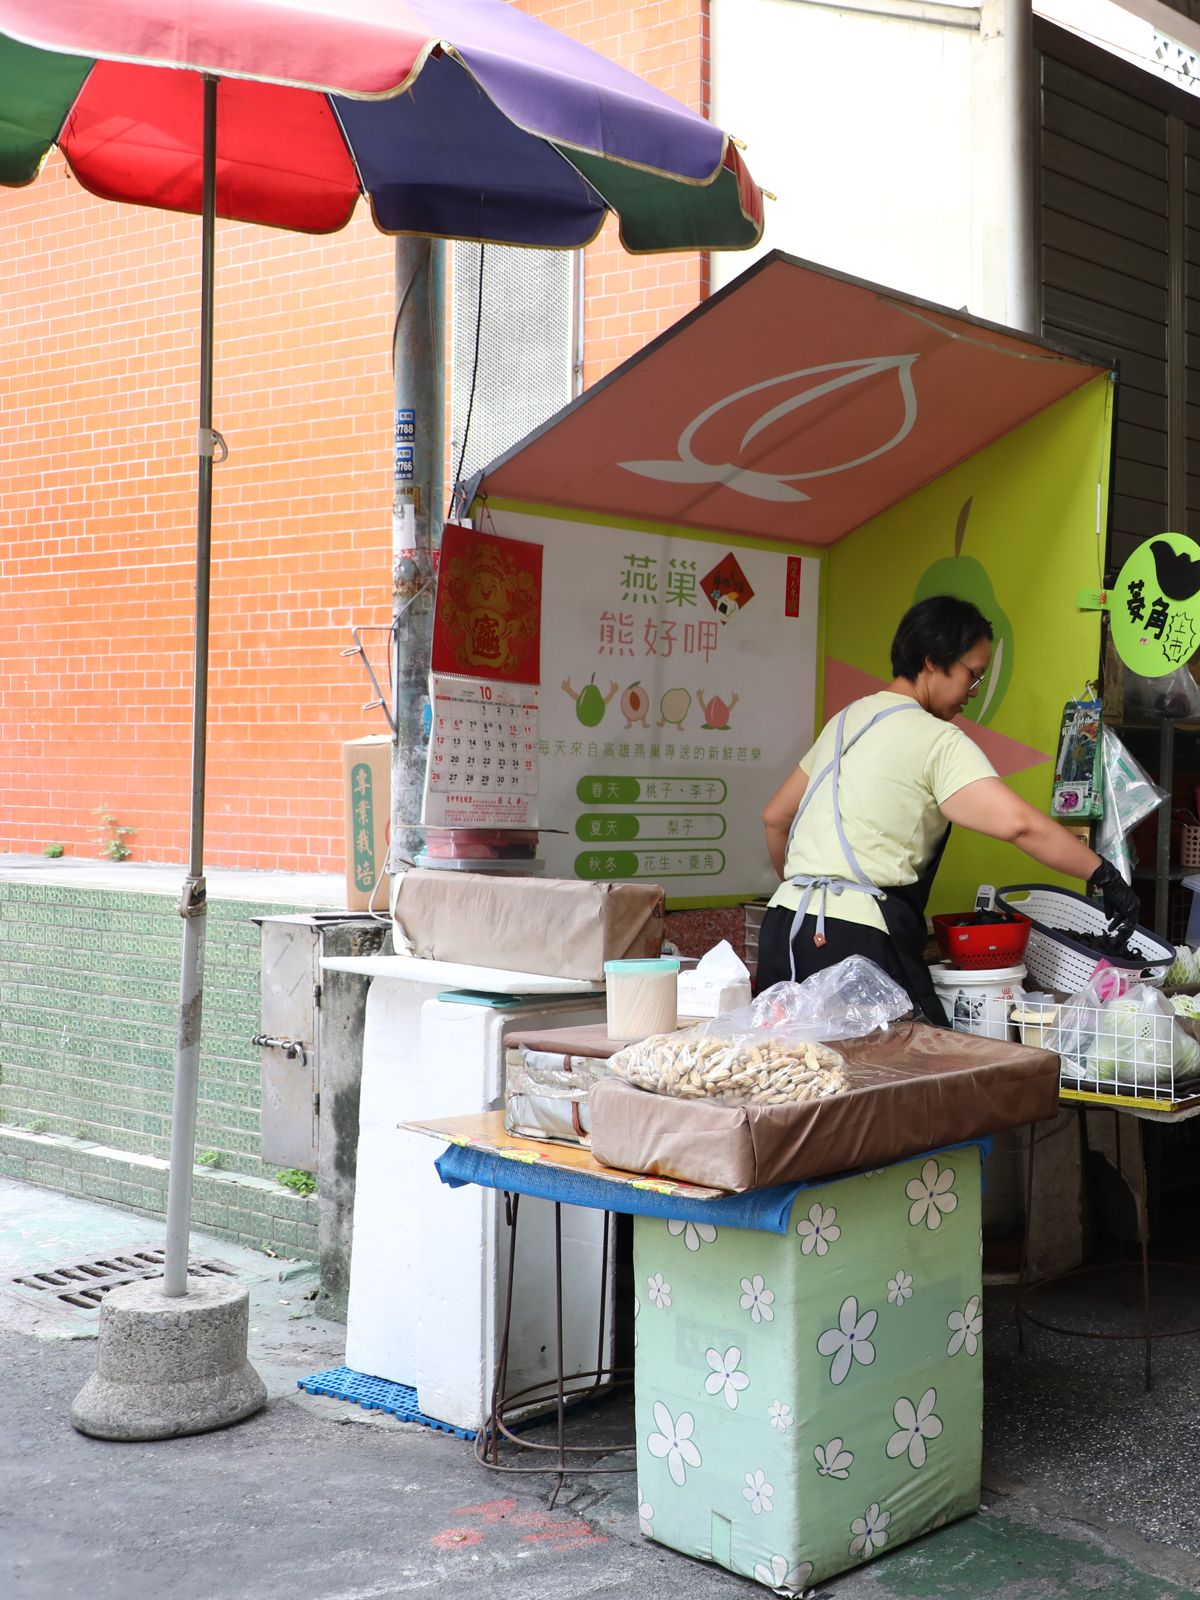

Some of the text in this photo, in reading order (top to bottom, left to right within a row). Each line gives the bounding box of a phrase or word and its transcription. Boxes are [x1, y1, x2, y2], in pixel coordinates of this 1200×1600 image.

[620, 554, 697, 607] 燕巢
[1127, 579, 1171, 640] 菱角
[598, 611, 718, 663] 熊好呷
[1170, 619, 1186, 657] 上市
[480, 686, 492, 700] 10
[591, 782, 620, 798] 春天
[646, 782, 717, 799] 桃子、李子
[354, 768, 374, 886] 專業栽培
[590, 820, 618, 836] 夏天
[667, 820, 694, 836] 梨子
[588, 856, 617, 872] 秋冬
[644, 854, 714, 871] 花生、菱角
